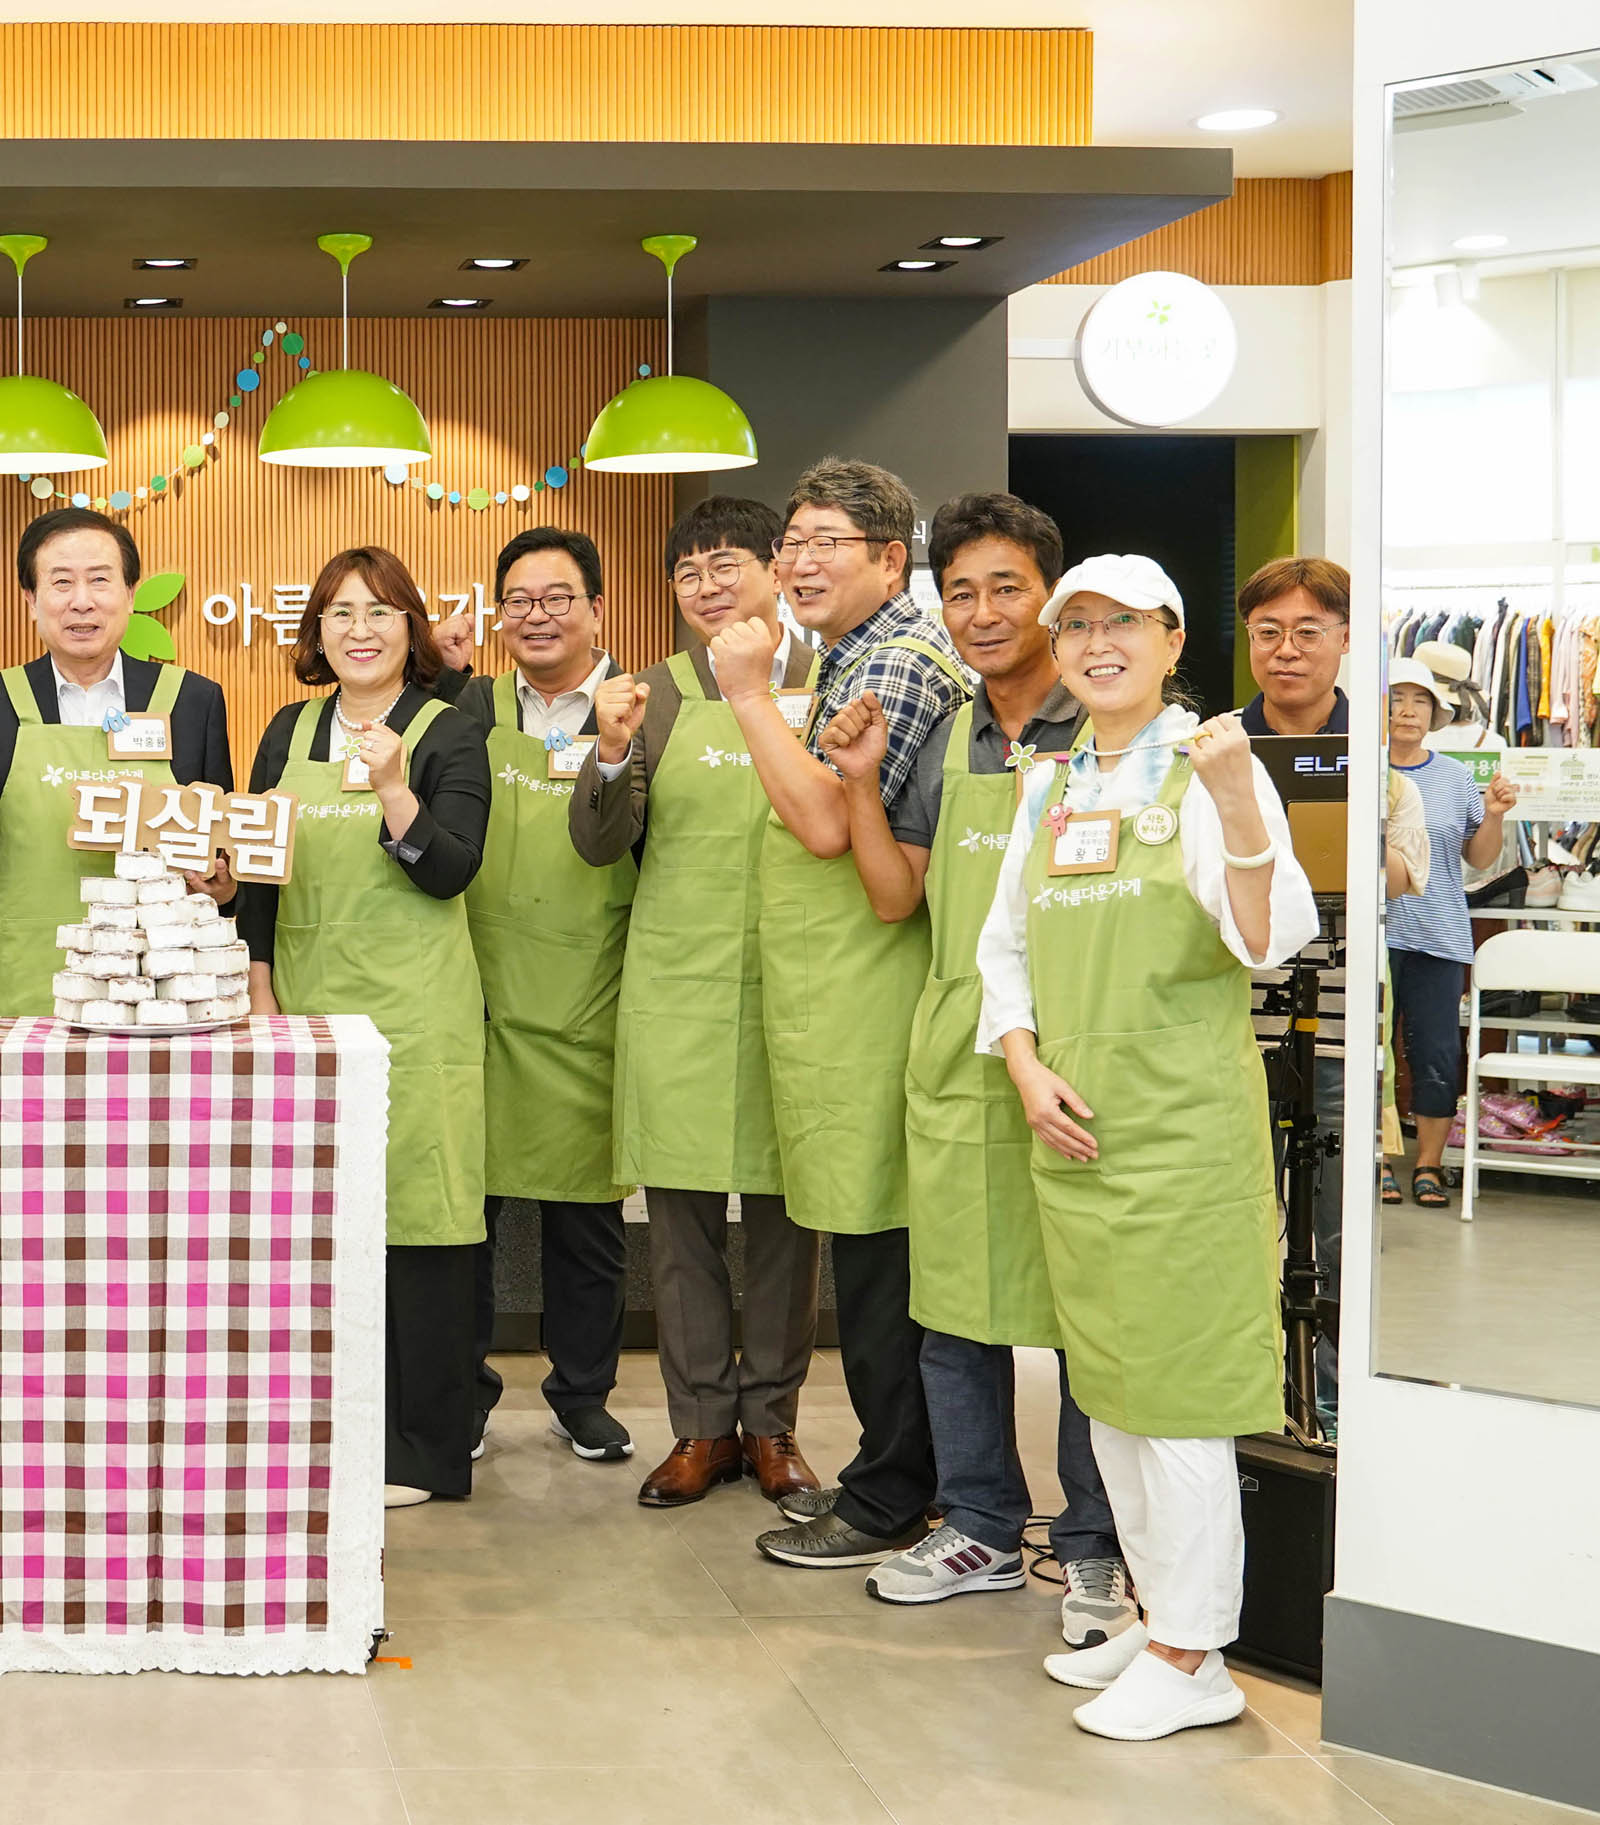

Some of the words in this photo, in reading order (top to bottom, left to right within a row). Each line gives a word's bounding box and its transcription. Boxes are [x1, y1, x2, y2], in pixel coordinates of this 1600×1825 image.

[307, 802, 378, 819] 아름다운가게
[73, 780, 292, 878] 되살림
[1054, 877, 1141, 908] 아름다운가게
